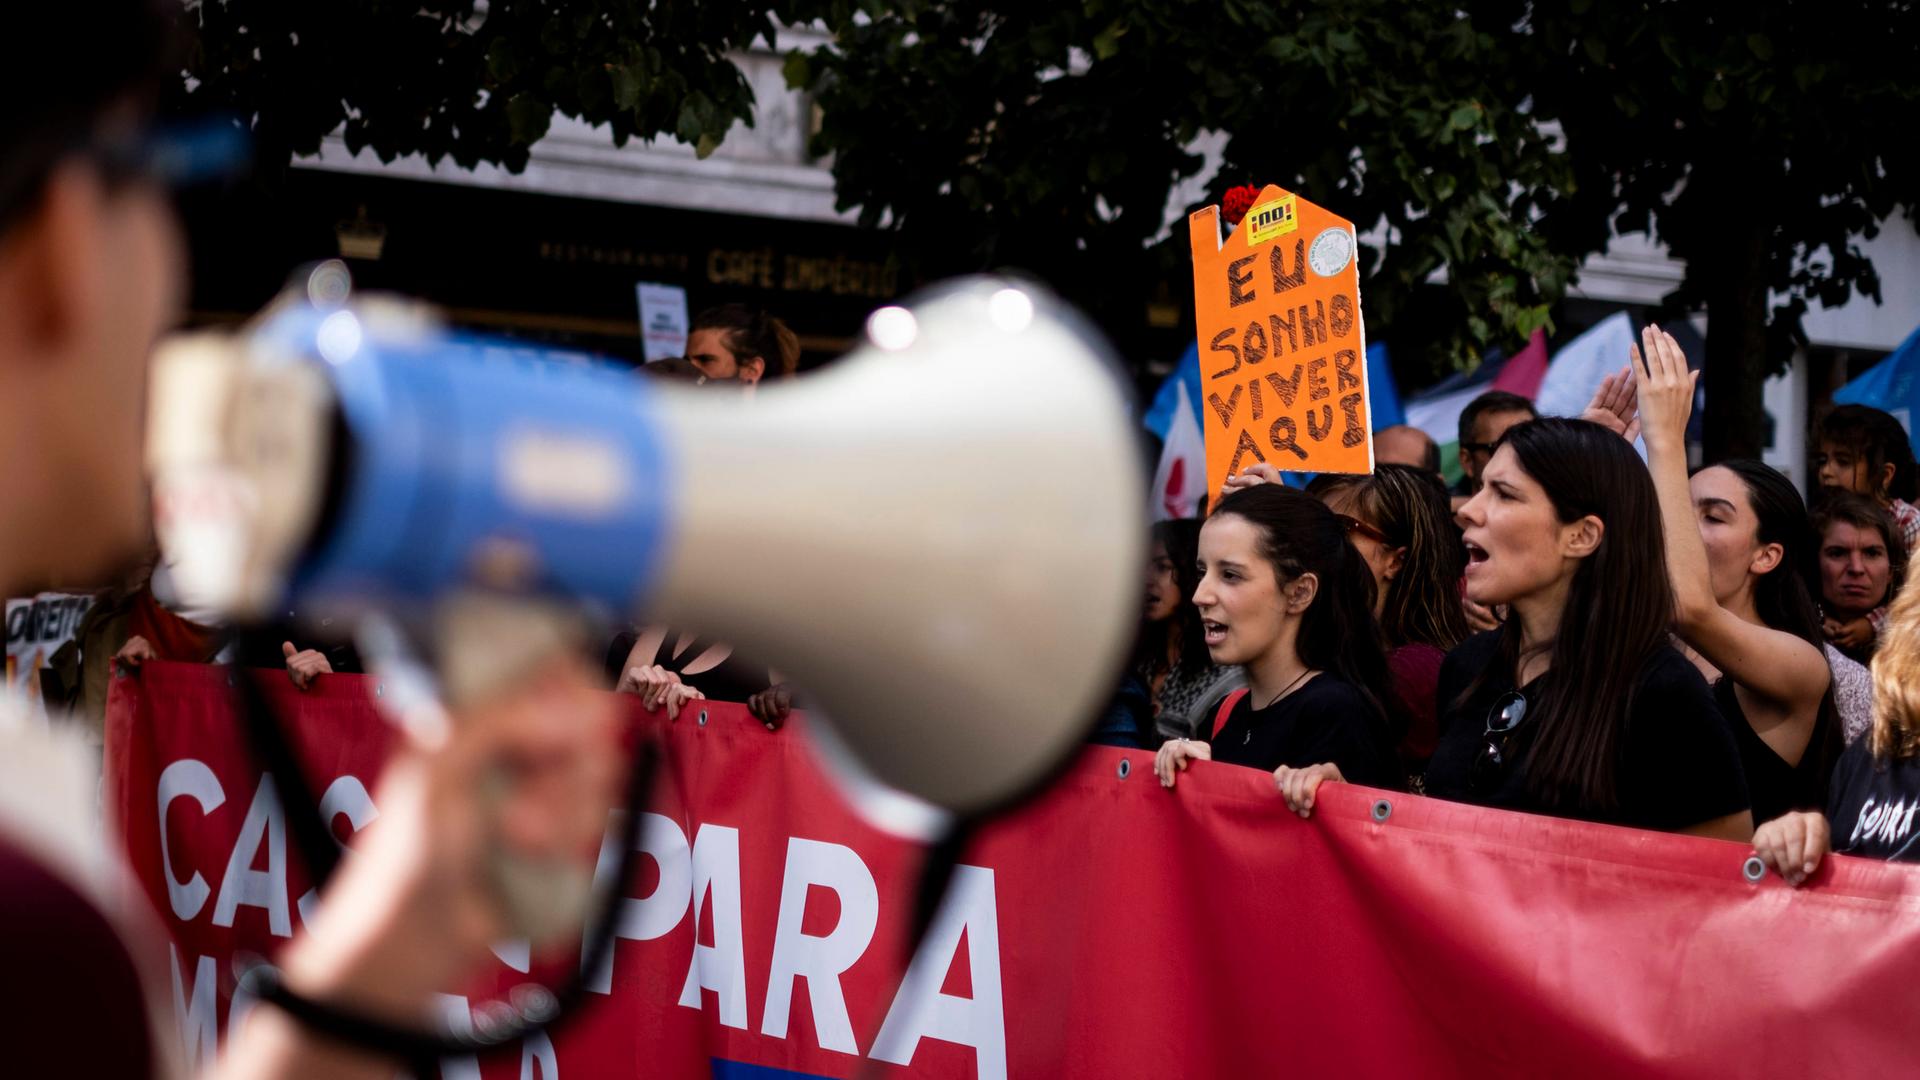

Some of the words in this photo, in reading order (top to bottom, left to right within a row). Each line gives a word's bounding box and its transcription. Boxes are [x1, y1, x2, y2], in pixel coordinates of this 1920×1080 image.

[706, 244, 776, 288] CAFÉ
[1227, 238, 1306, 308] EU
[1210, 293, 1353, 380] SONHO
[1207, 349, 1361, 429] VIVER
[1222, 392, 1366, 487] AQUI
[579, 807, 1008, 1080] PARA
